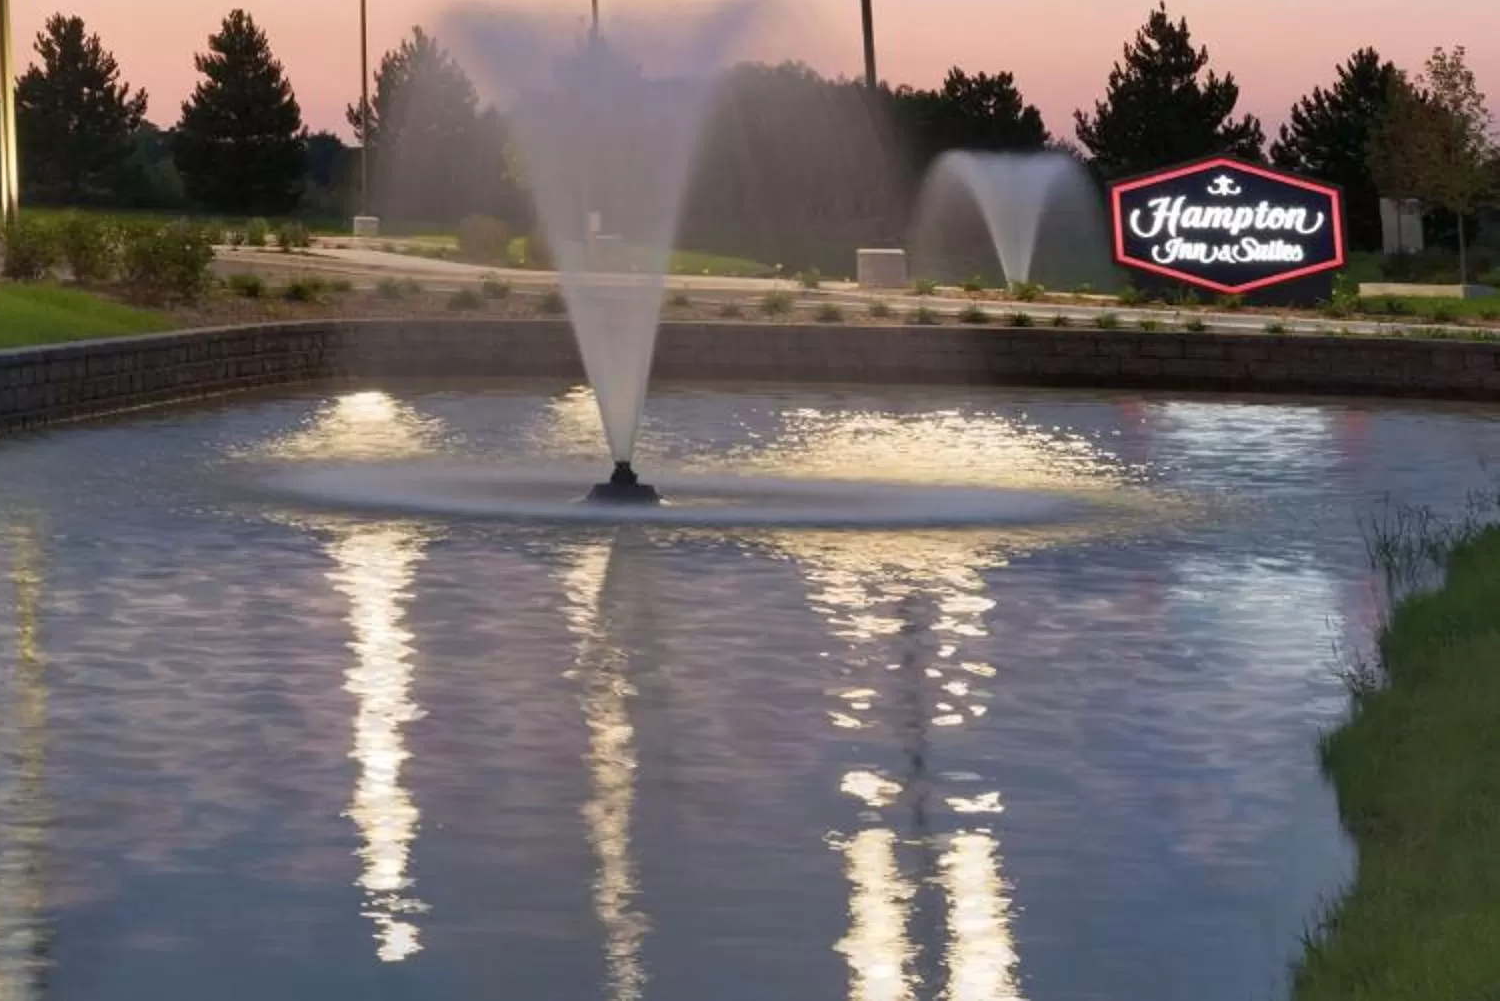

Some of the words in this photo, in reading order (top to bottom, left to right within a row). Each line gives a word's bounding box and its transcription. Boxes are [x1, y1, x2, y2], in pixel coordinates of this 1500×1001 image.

[1129, 195, 1325, 238] Hampton
[1151, 237, 1218, 264] Inn
[1217, 248, 1237, 264] &
[1233, 237, 1305, 263] Suites
